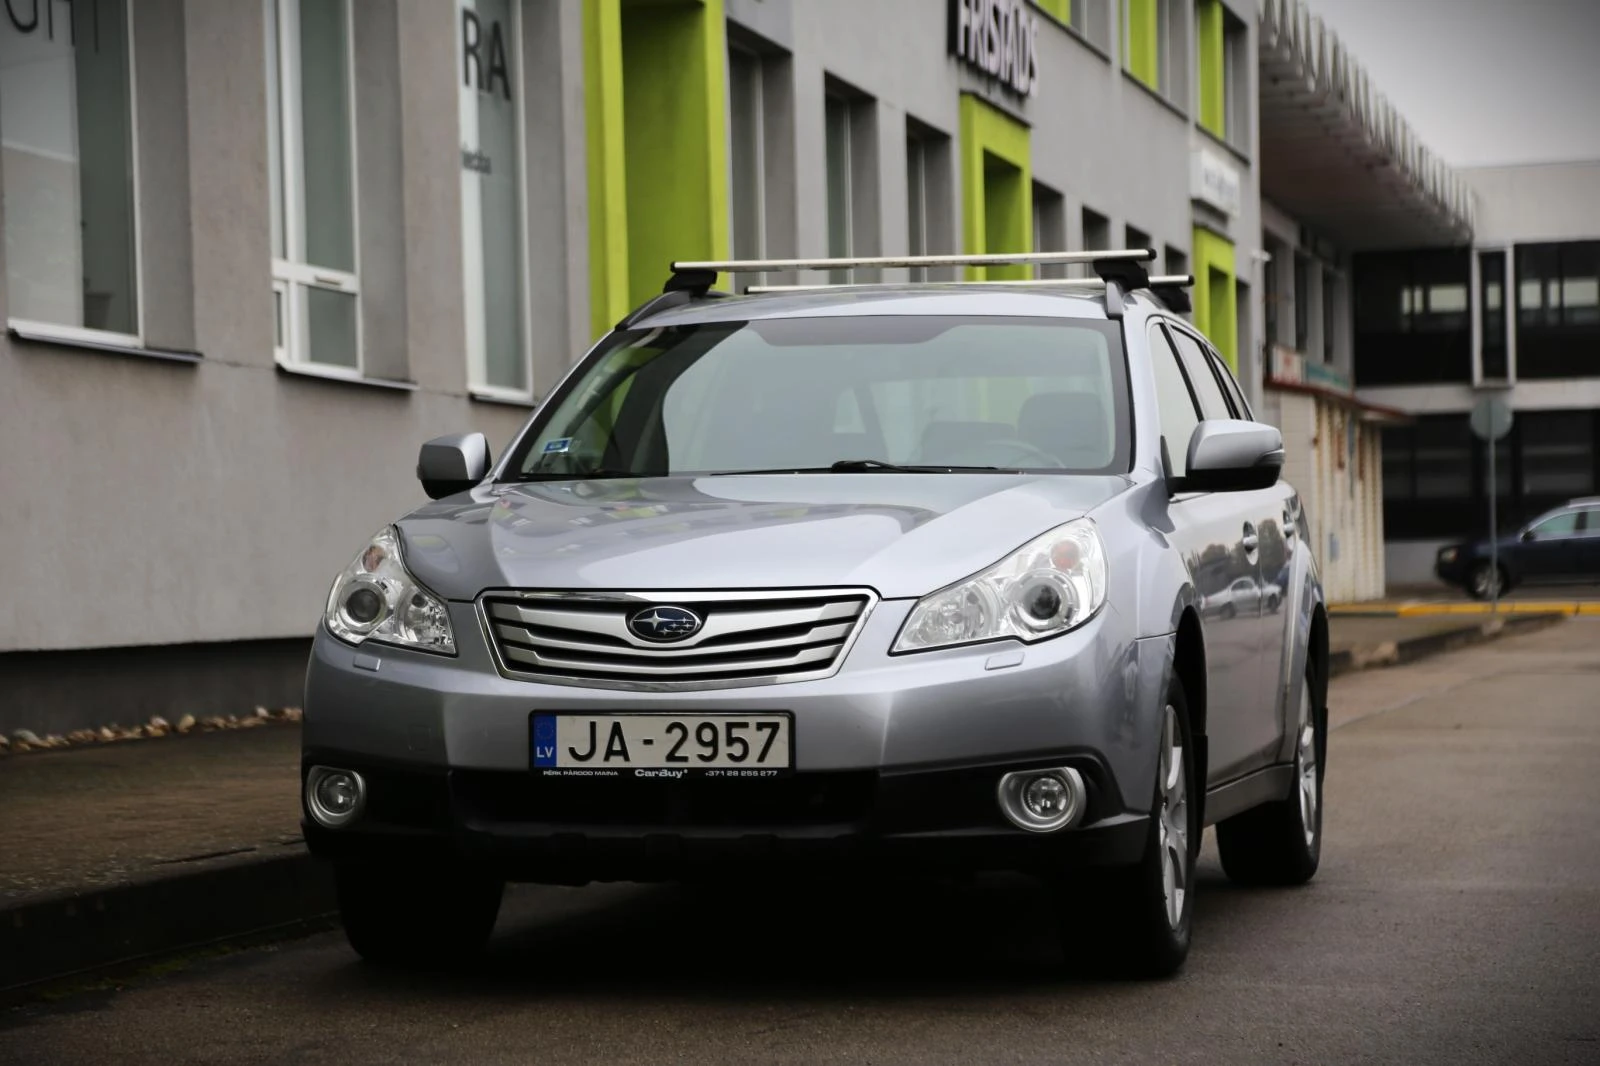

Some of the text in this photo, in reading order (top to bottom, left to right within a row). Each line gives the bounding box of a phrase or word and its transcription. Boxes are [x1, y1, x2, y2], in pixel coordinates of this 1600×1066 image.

[957, 0, 1040, 98] FRISTADS
[536, 746, 554, 758] LV
[568, 721, 781, 763] JA-2957
